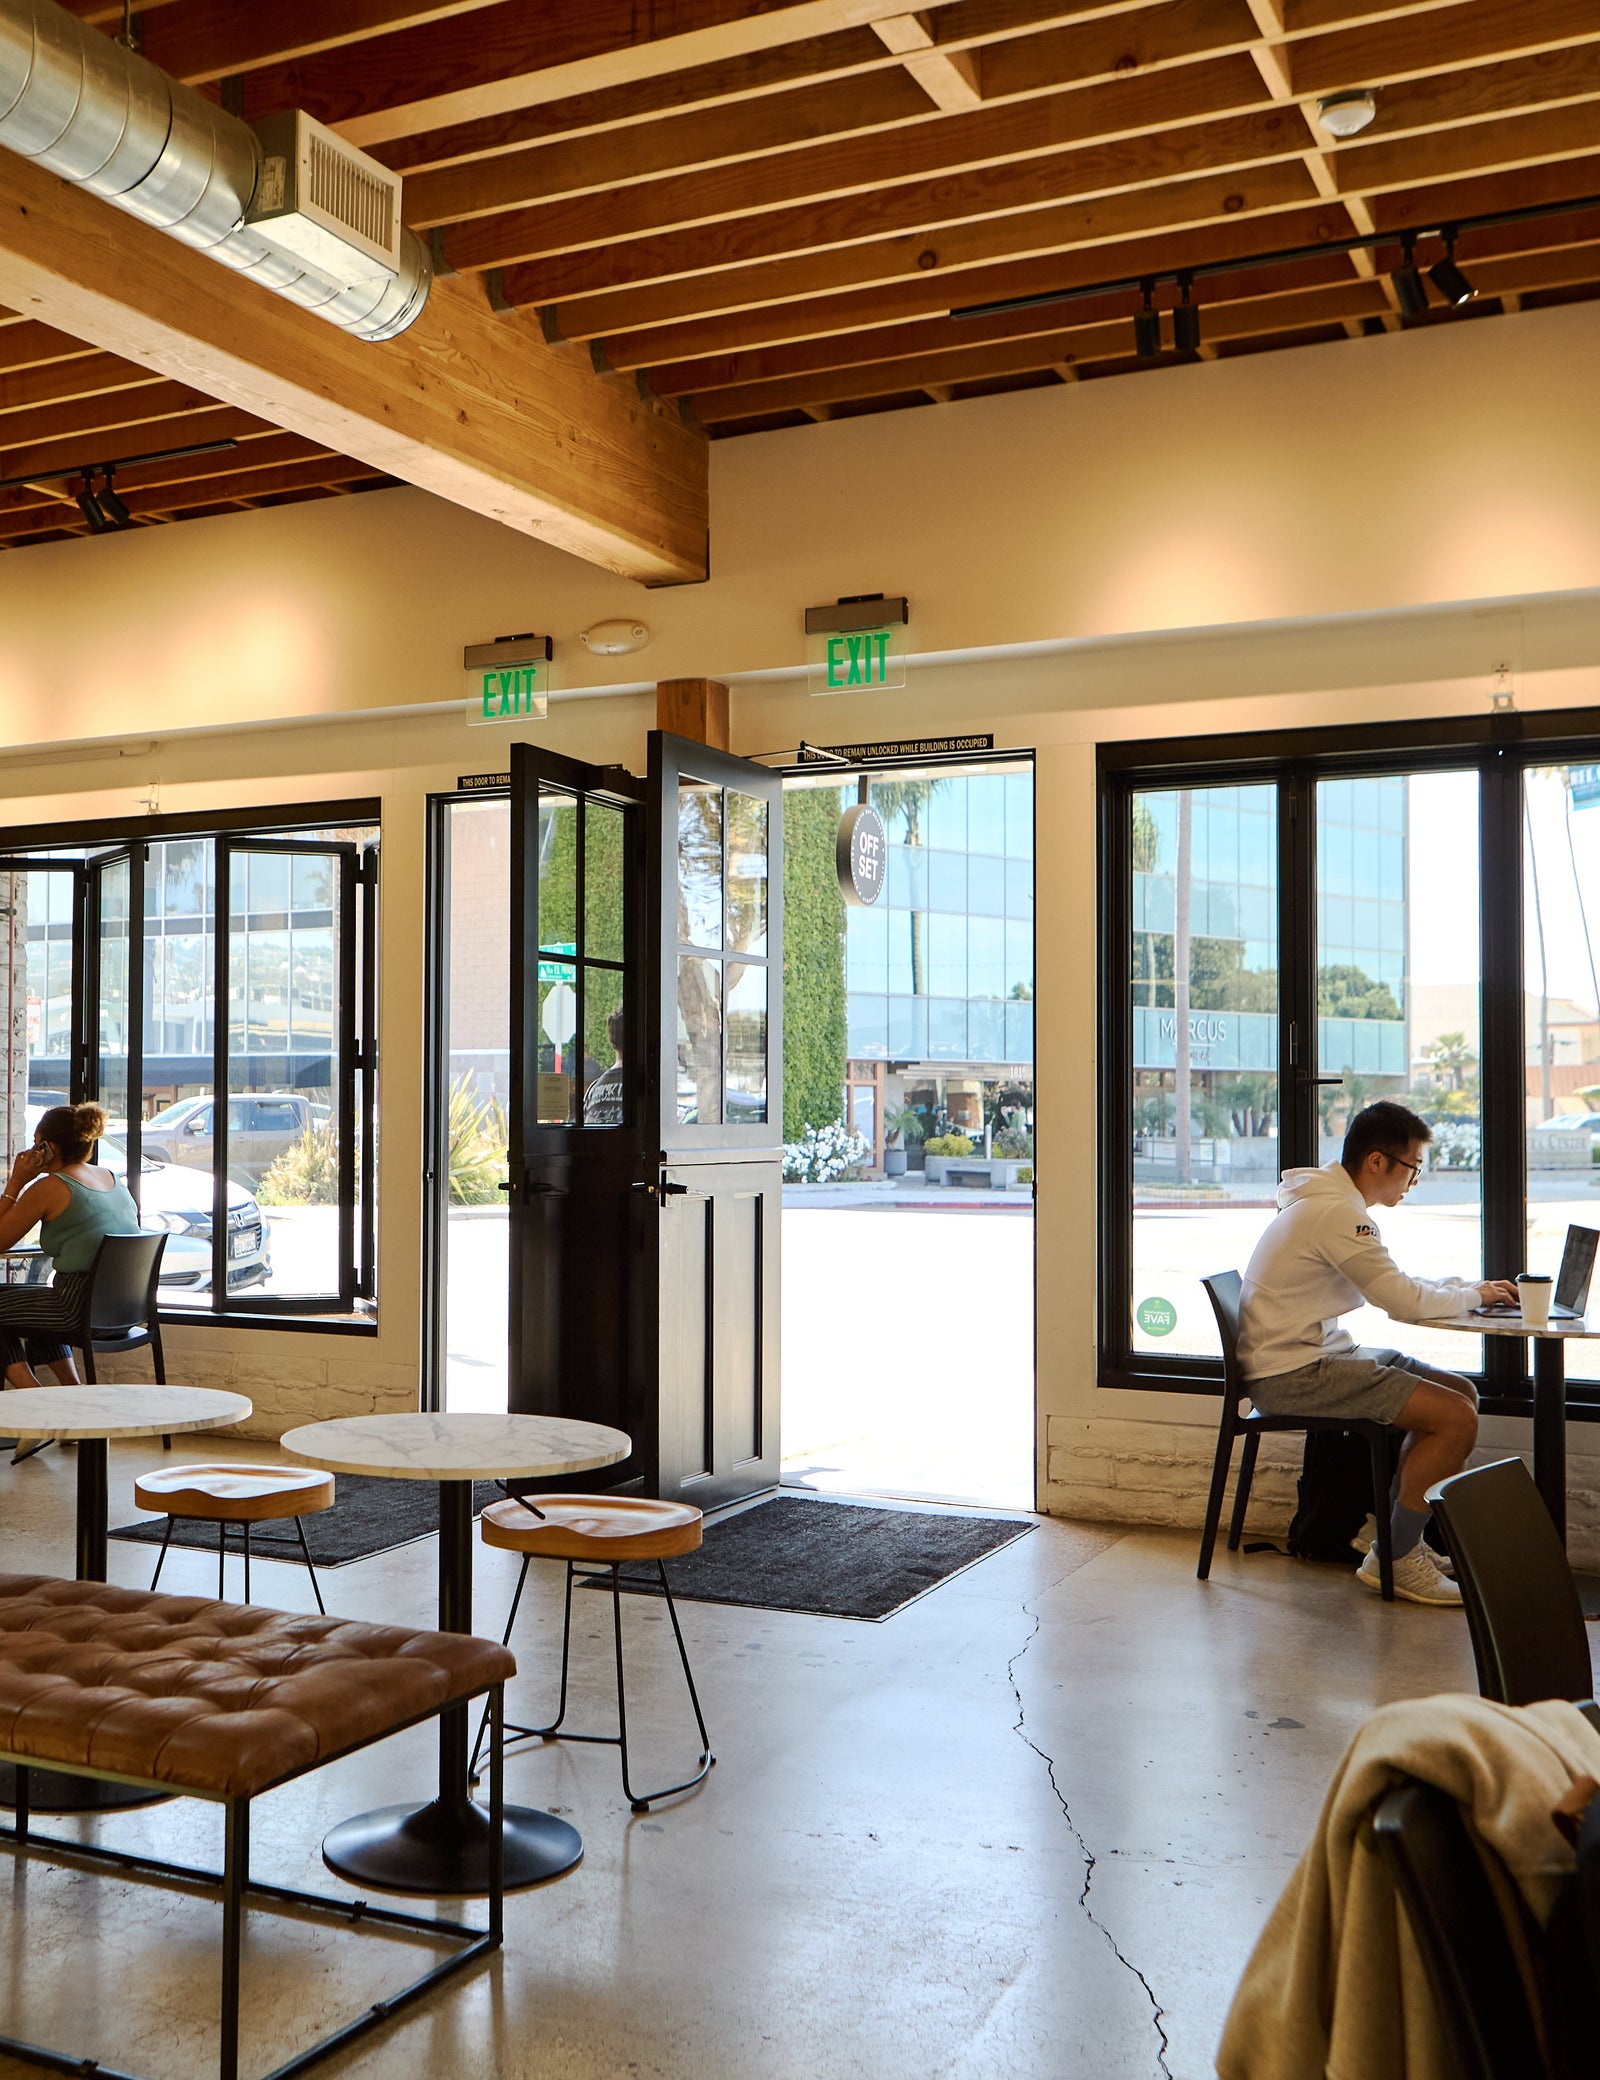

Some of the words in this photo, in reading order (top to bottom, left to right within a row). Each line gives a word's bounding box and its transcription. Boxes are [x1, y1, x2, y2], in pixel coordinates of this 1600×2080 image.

[828, 632, 890, 688] EXIT
[483, 668, 536, 718] EXIT
[804, 750, 816, 760] THIS
[843, 747, 866, 757] REMAIN
[867, 744, 899, 756] UNLOCKED
[900, 743, 919, 754] WHILE
[920, 741, 948, 752] BUILDING
[949, 740, 955, 750] IS
[956, 738, 988, 749] OCCUPIED
[462, 777, 474, 788] THIS
[474, 776, 488, 786] DOOR
[489, 776, 496, 785] TO
[496, 774, 511, 784] REMA
[860, 832, 880, 857] OFF
[858, 854, 879, 881] SET
[1160, 1018, 1227, 1041] MRCUS
